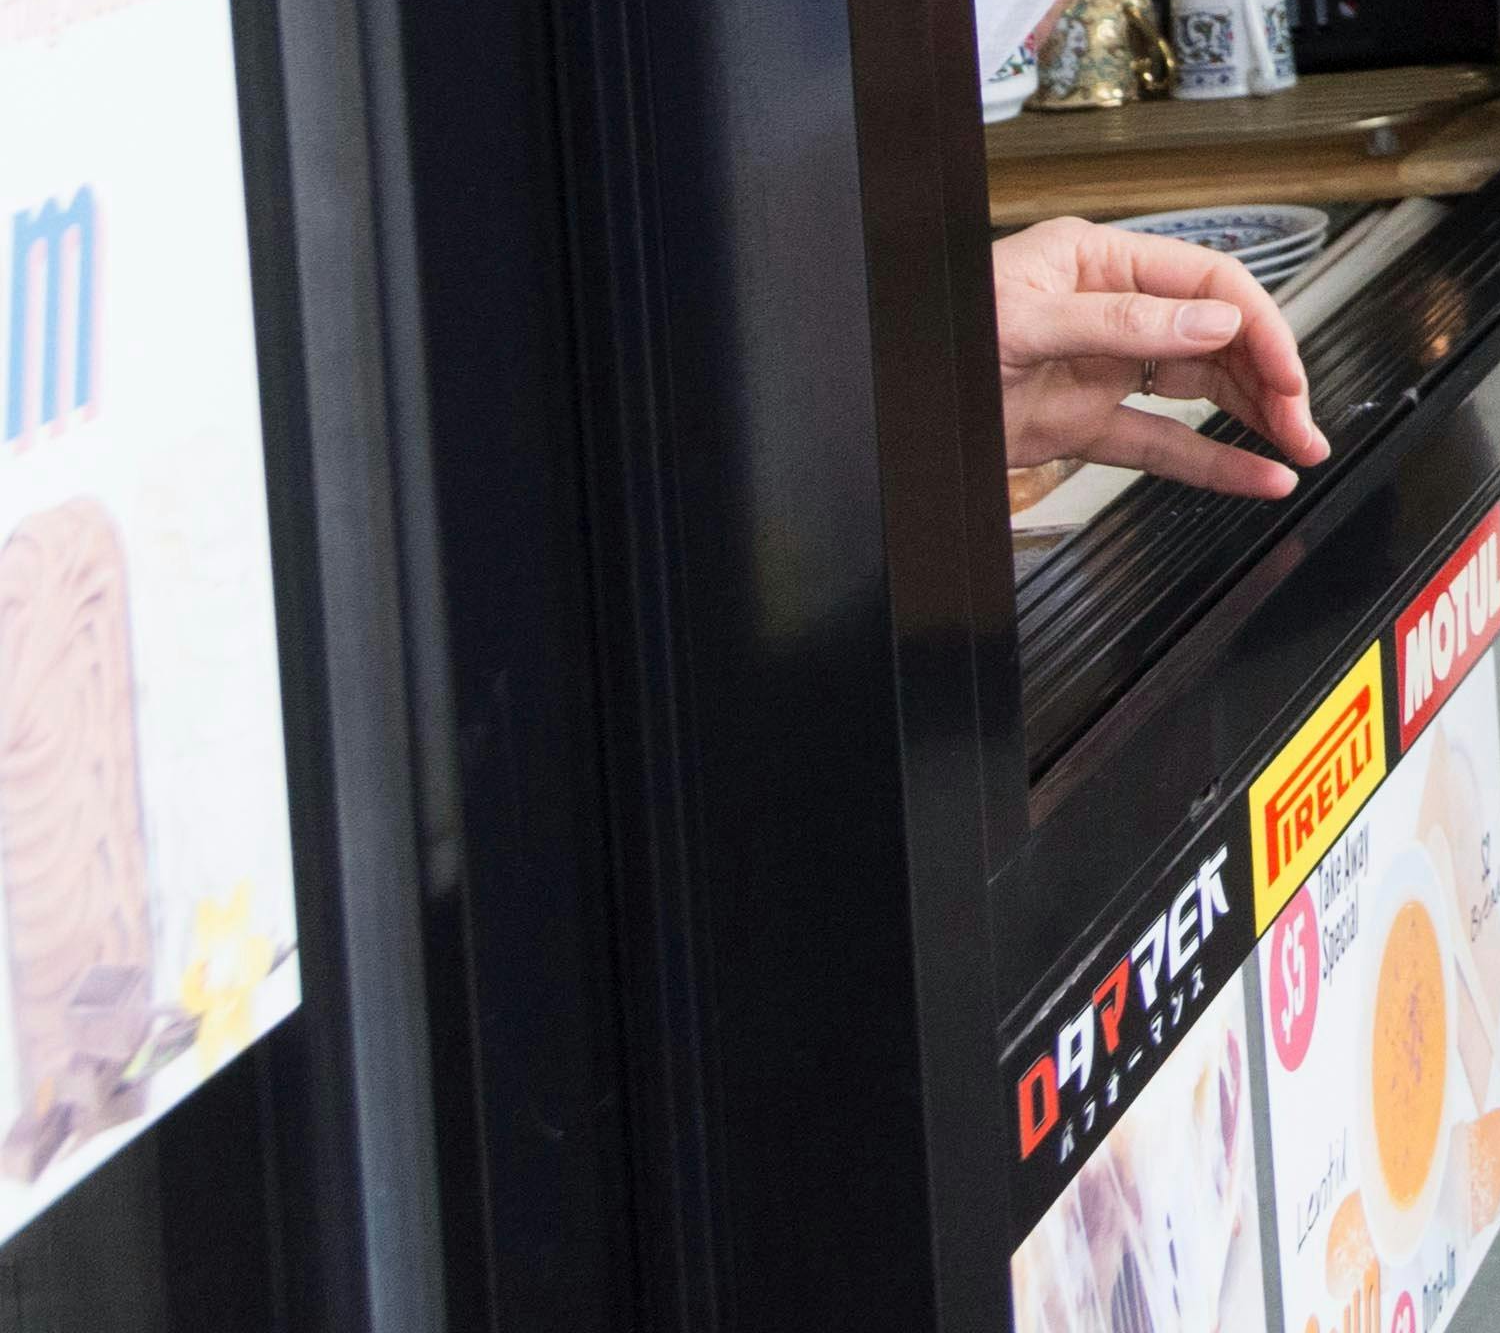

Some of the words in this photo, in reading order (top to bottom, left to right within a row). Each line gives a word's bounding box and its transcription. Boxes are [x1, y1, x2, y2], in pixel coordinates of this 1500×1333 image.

[1264, 683, 1372, 889] PIRELLI
[1317, 851, 1342, 915] Take
[1344, 820, 1370, 881] Away
[1280, 911, 1307, 1046] $5
[1322, 883, 1359, 987] Special
